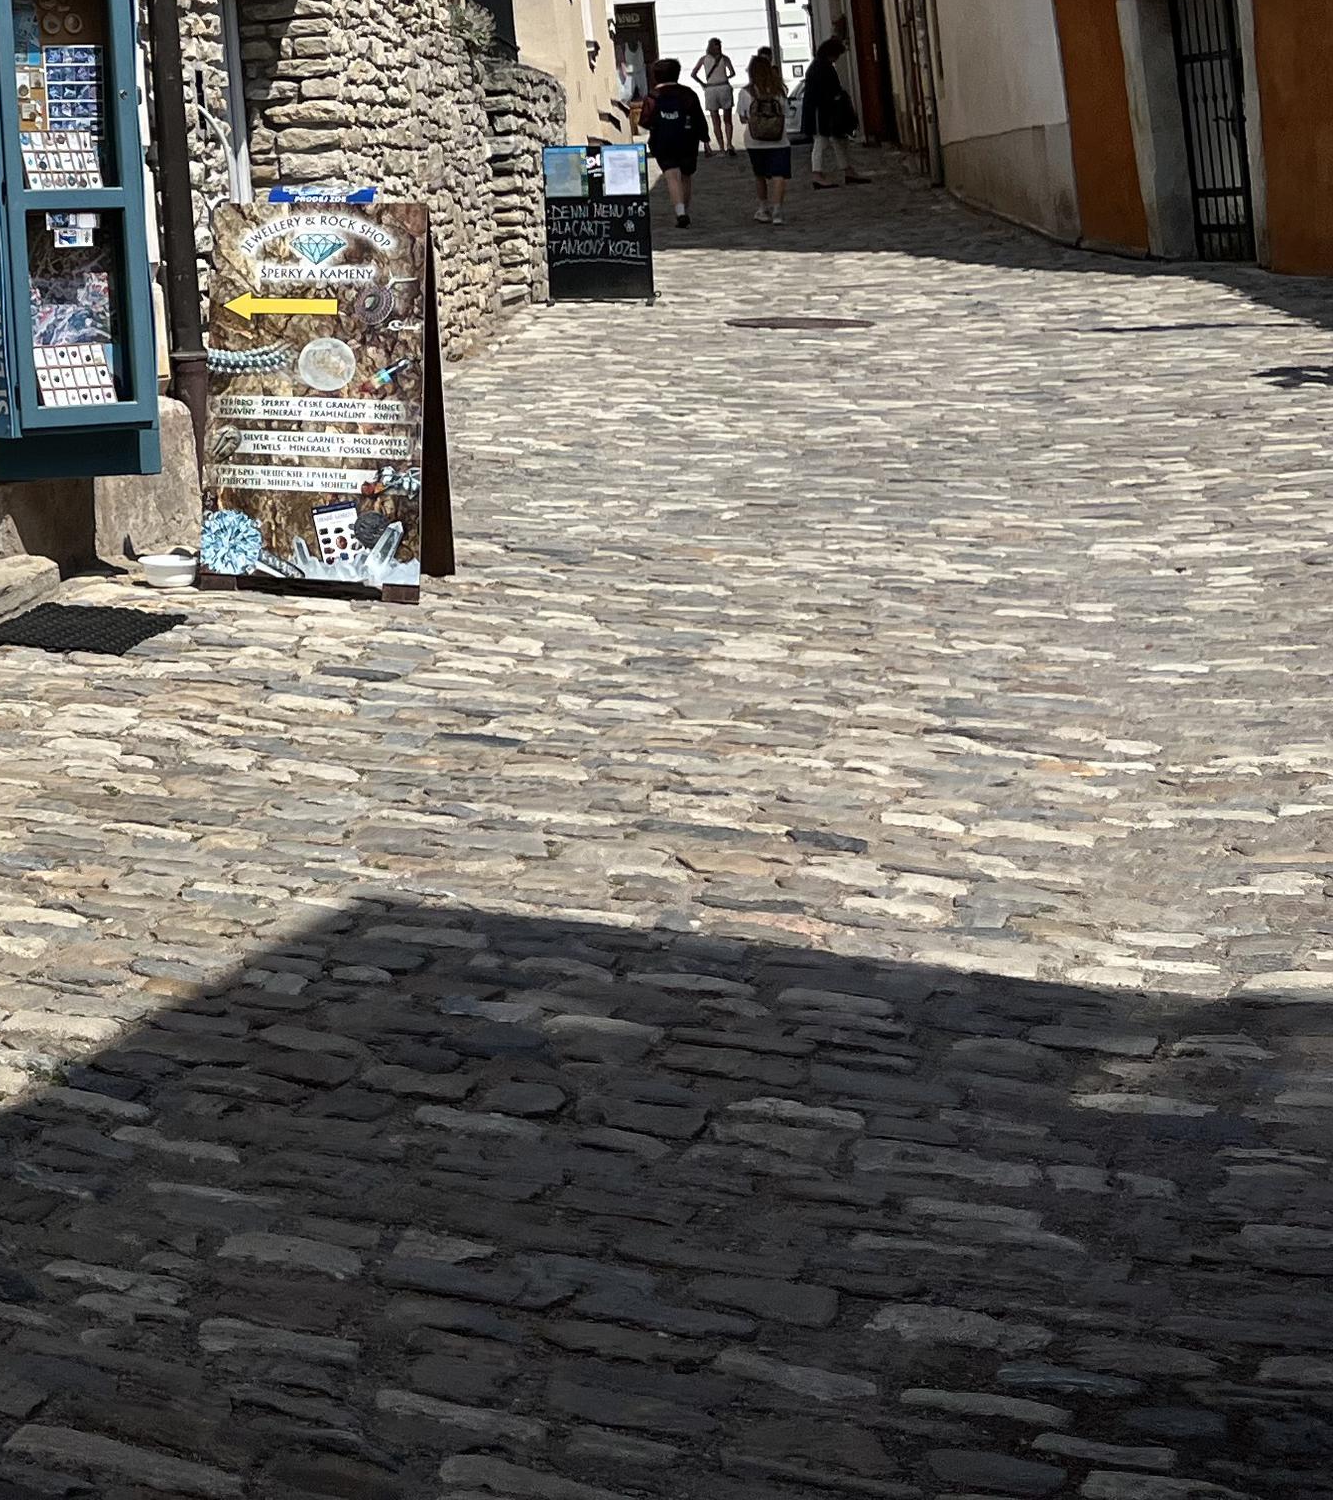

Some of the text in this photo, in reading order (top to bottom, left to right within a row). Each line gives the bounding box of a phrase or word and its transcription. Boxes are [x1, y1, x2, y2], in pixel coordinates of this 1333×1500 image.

[593, 202, 624, 218] MENU
[241, 215, 391, 253] JEWELLERY & ROCK SHOP
[608, 240, 649, 259] KOZEL
[261, 265, 374, 279] ŠPERKY A KAMENY
[261, 398, 290, 407] ŠPERKY
[297, 399, 322, 408] ČESKÉ
[325, 400, 367, 410] GRANÁTY
[243, 433, 270, 441] SILVER
[277, 435, 304, 443] CZECH
[307, 435, 345, 444] GARNETS
[252, 443, 408, 456] JEWELS MINERALS FOSSILS COINS
